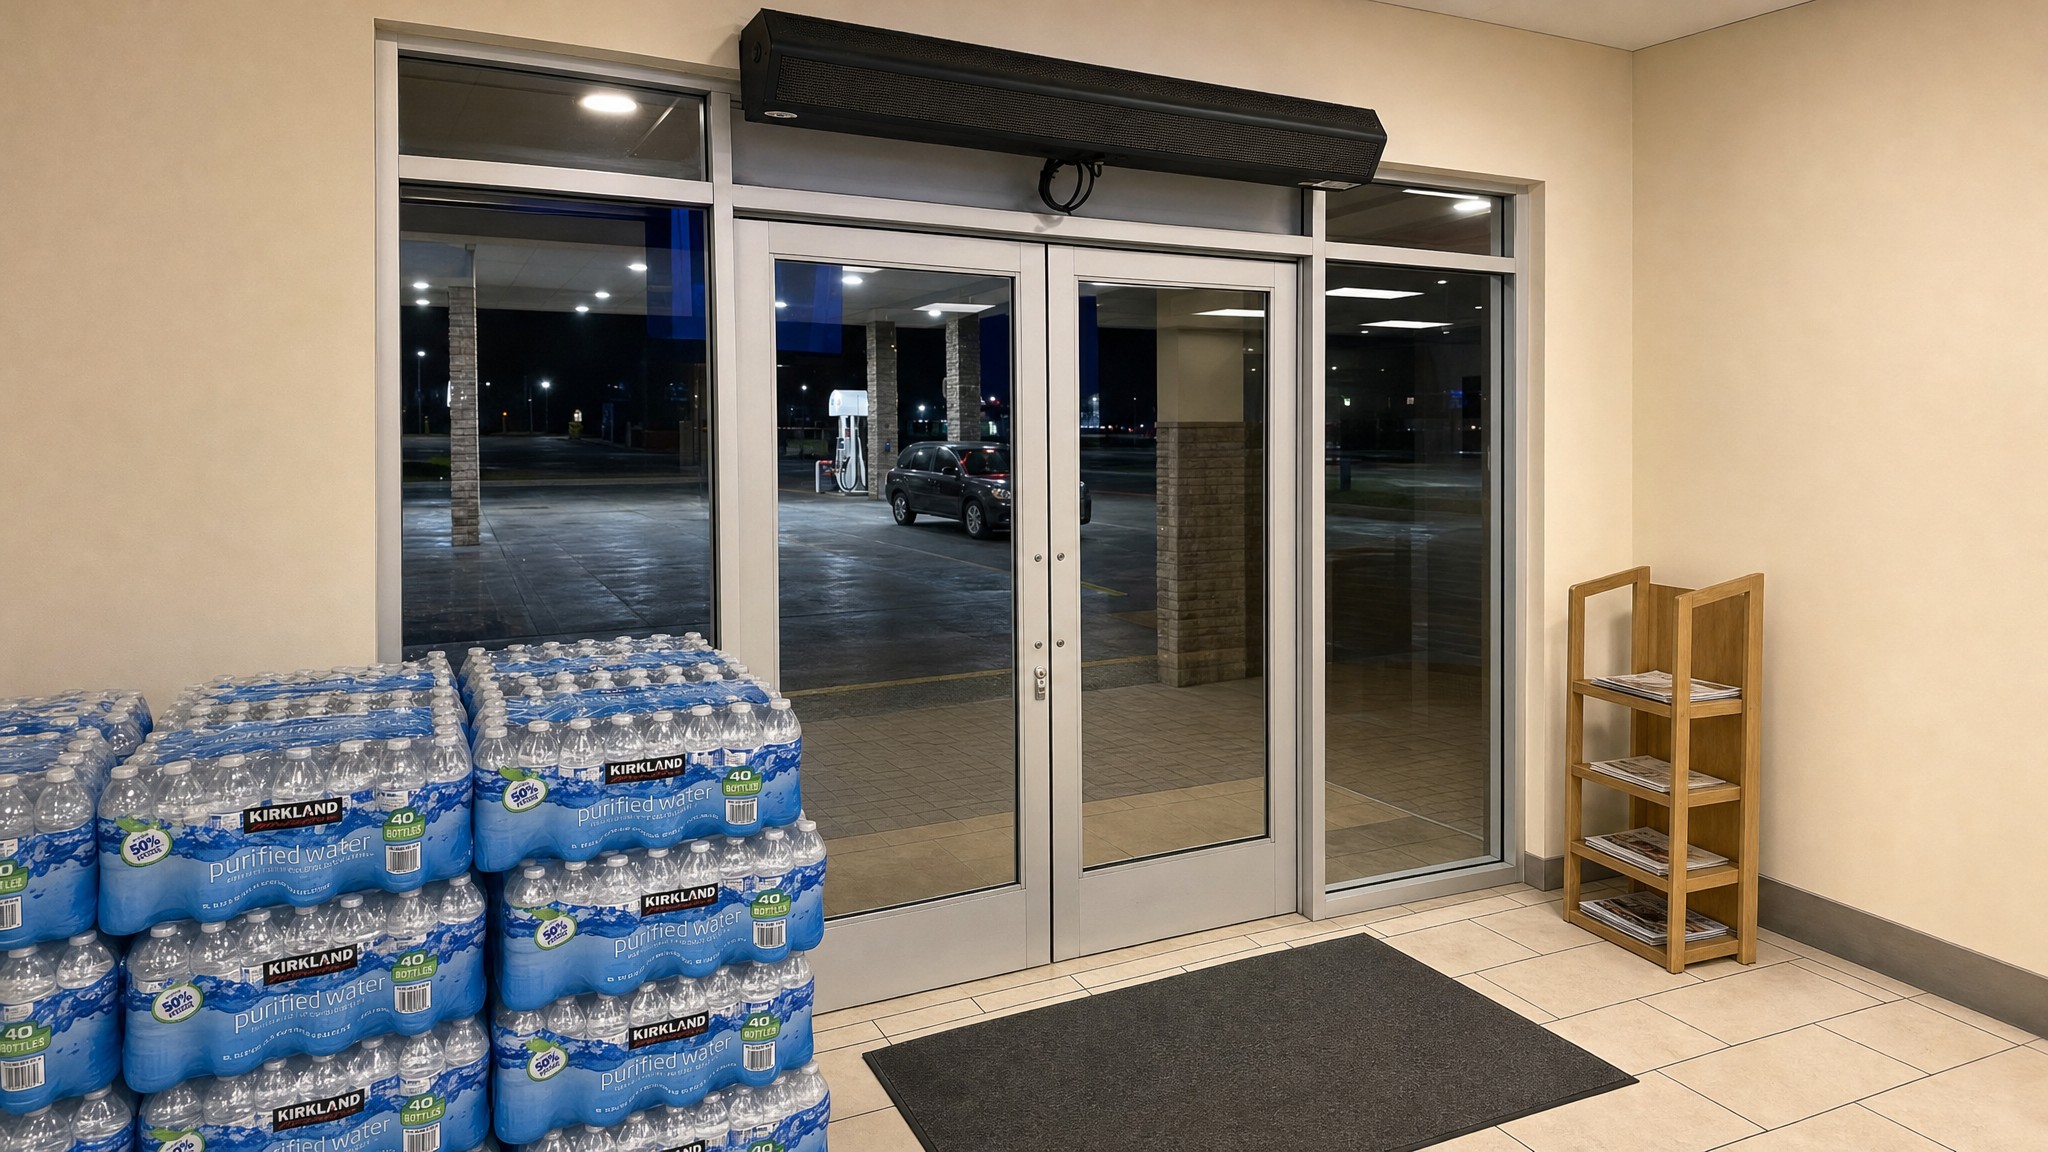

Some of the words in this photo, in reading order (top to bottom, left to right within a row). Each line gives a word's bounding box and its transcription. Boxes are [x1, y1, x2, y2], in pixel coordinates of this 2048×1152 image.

[610, 758, 683, 776] KIRKLAND
[730, 770, 752, 781] 40
[511, 783, 539, 802] 50%
[250, 802, 338, 823] KIRKLAND
[577, 795, 653, 827] purified
[659, 787, 713, 811] water
[391, 812, 414, 825] 40
[130, 834, 161, 856] 50%
[209, 845, 300, 884] purified
[305, 835, 372, 864] water
[0, 864, 13, 877] 0
[645, 886, 716, 908] KIRKLAND
[758, 893, 780, 904] 40
[543, 920, 568, 941] 50%
[614, 920, 688, 958] purified
[693, 910, 742, 936] water
[269, 949, 353, 976] KIRKLAND
[401, 953, 425, 967] 40
[162, 991, 193, 1012] 50%
[234, 990, 320, 1034] purified
[326, 976, 386, 1006] water
[633, 1015, 706, 1041] KIRKLAND
[749, 1015, 770, 1027] 40
[5, 1025, 33, 1040] 40
[535, 1051, 560, 1072] 50%
[601, 1051, 677, 1091] purified
[682, 1036, 732, 1066] water
[278, 1093, 361, 1122] KIRKLAND
[409, 1096, 433, 1111] 40
[332, 1119, 391, 1151] water
